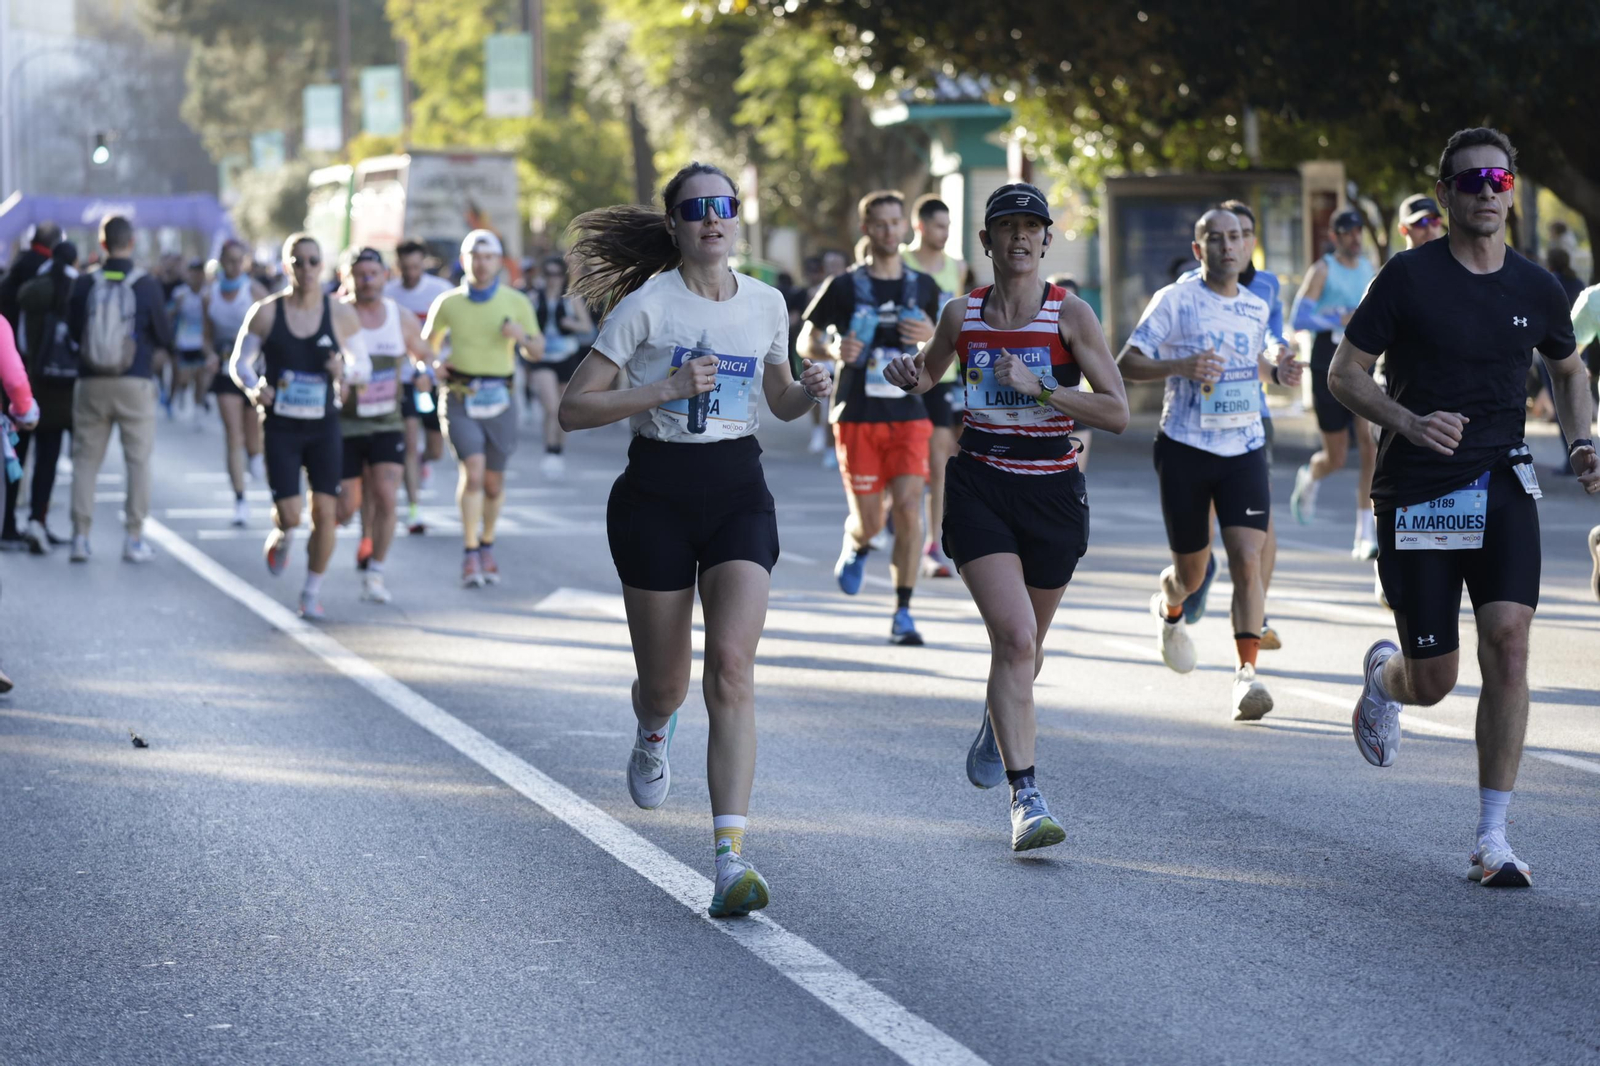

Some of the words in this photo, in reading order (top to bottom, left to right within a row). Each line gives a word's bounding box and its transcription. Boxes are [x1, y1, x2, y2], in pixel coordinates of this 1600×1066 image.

[713, 360, 748, 373] URICH
[1223, 370, 1253, 381] ZURICH
[985, 391, 1036, 406] LAURA
[1214, 399, 1250, 413] PEDRO
[1430, 498, 1455, 508] 5189
[1396, 516, 1407, 529] A
[1412, 515, 1485, 530] MARQUES
